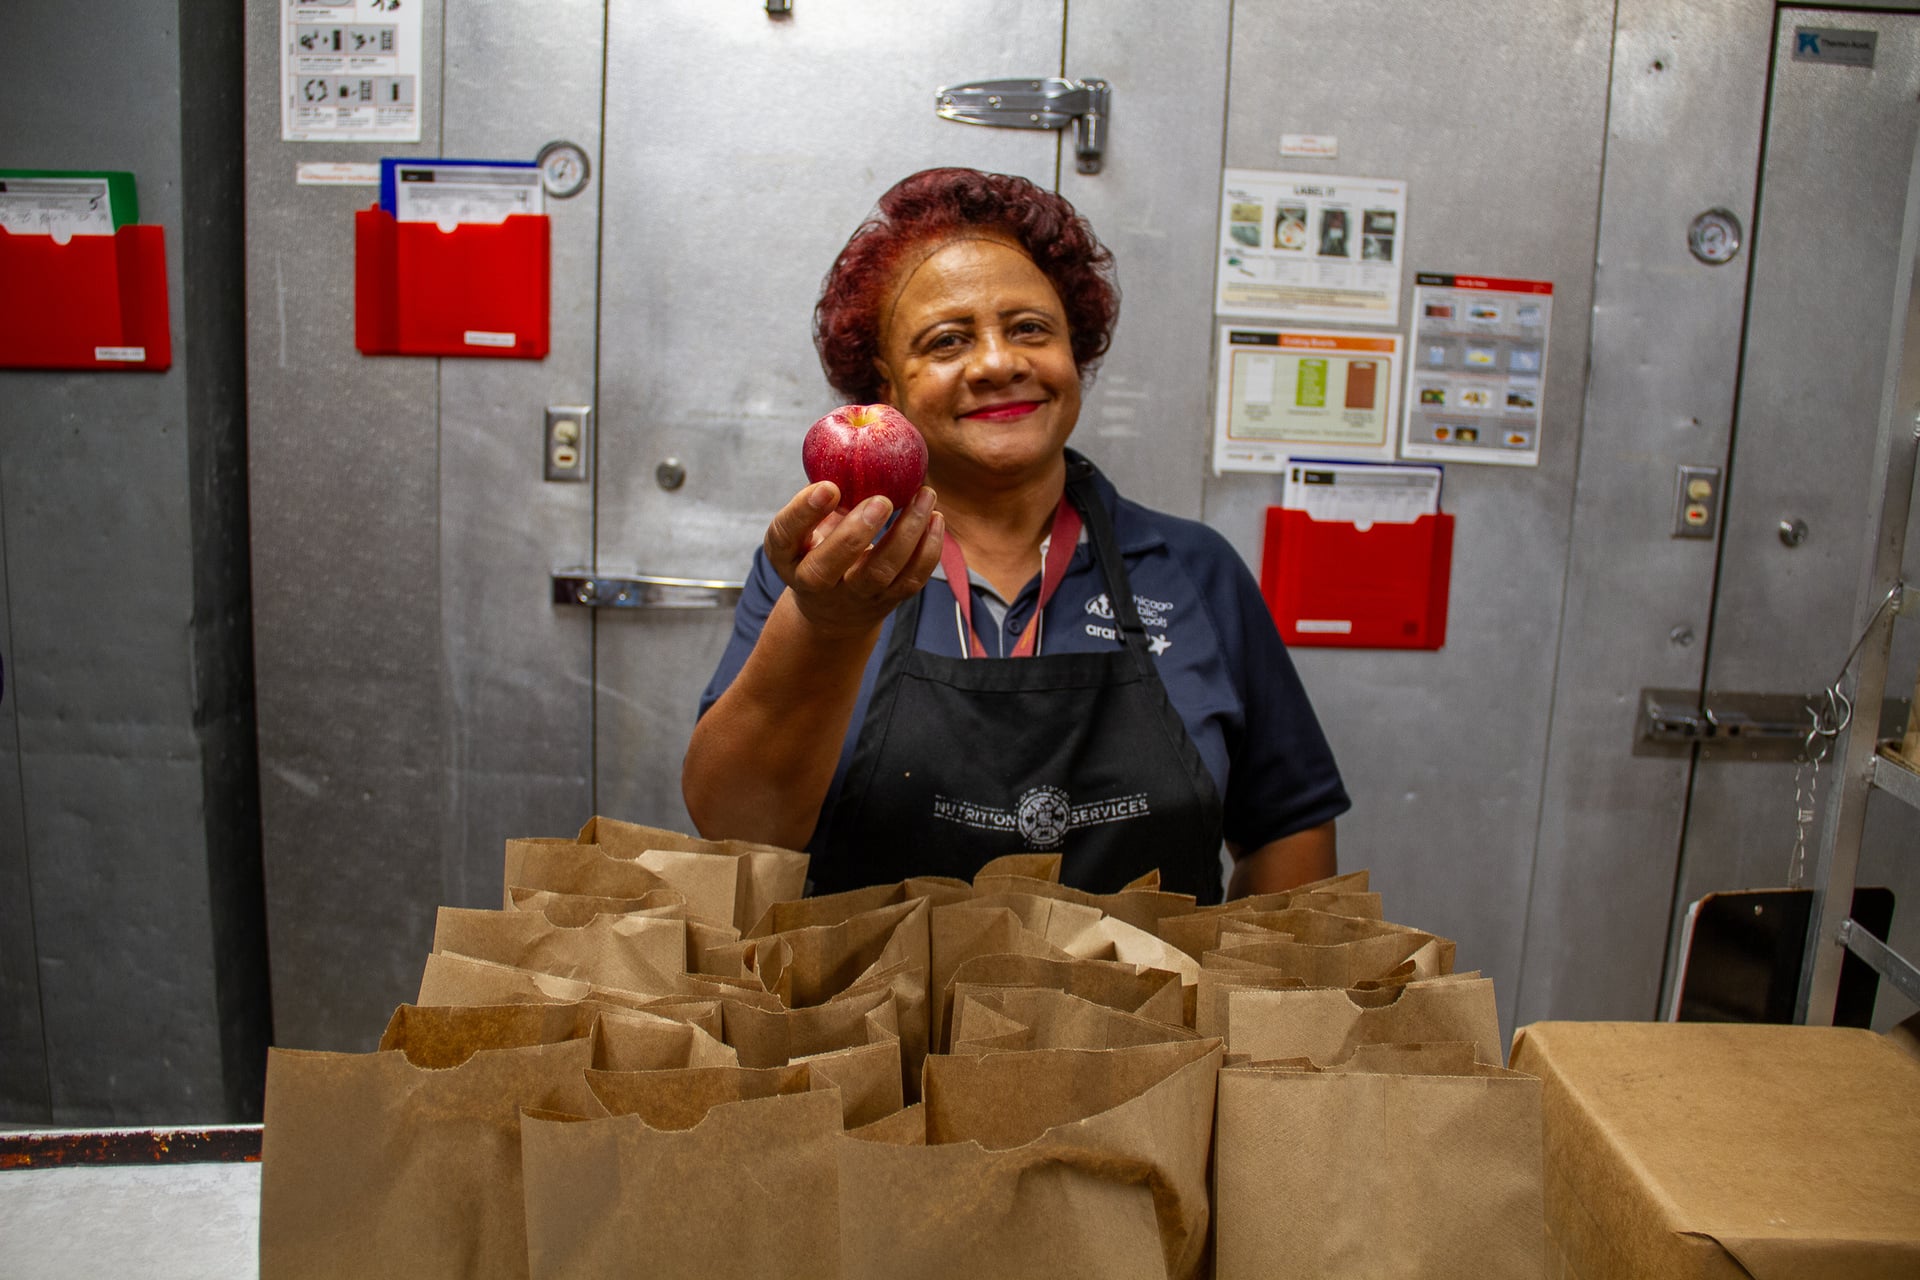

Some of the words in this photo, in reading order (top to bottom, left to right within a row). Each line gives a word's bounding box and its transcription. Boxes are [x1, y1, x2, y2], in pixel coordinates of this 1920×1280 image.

[1132, 594, 1174, 612] hicago
[934, 801, 1017, 827] NUTRITION
[1070, 798, 1149, 824] SERVICES
